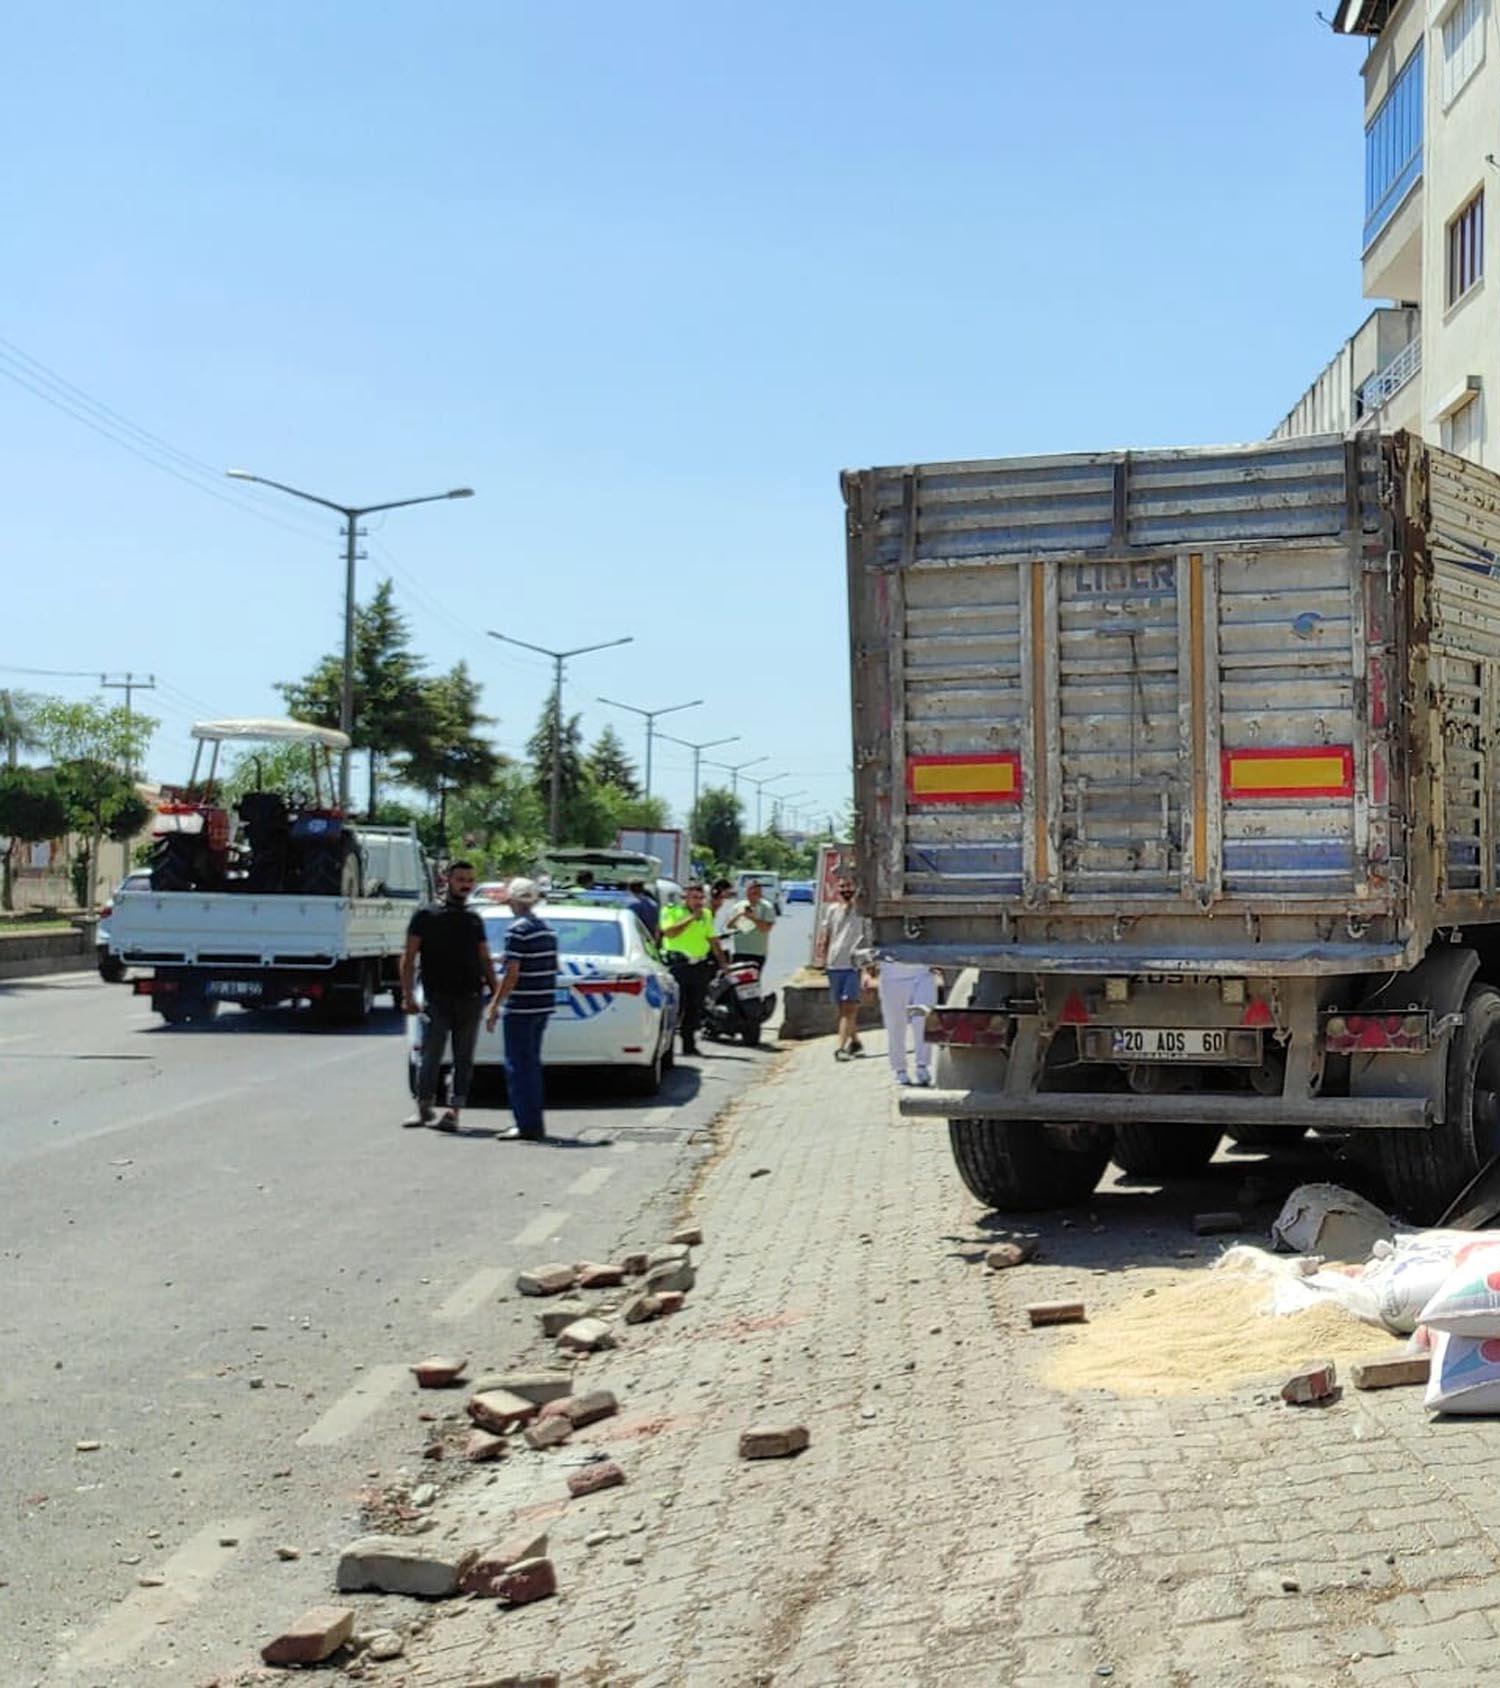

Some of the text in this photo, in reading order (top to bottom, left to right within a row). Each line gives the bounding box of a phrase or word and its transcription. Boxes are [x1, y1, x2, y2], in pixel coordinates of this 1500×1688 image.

[1124, 1031, 1222, 1051] 20 ADS 60
